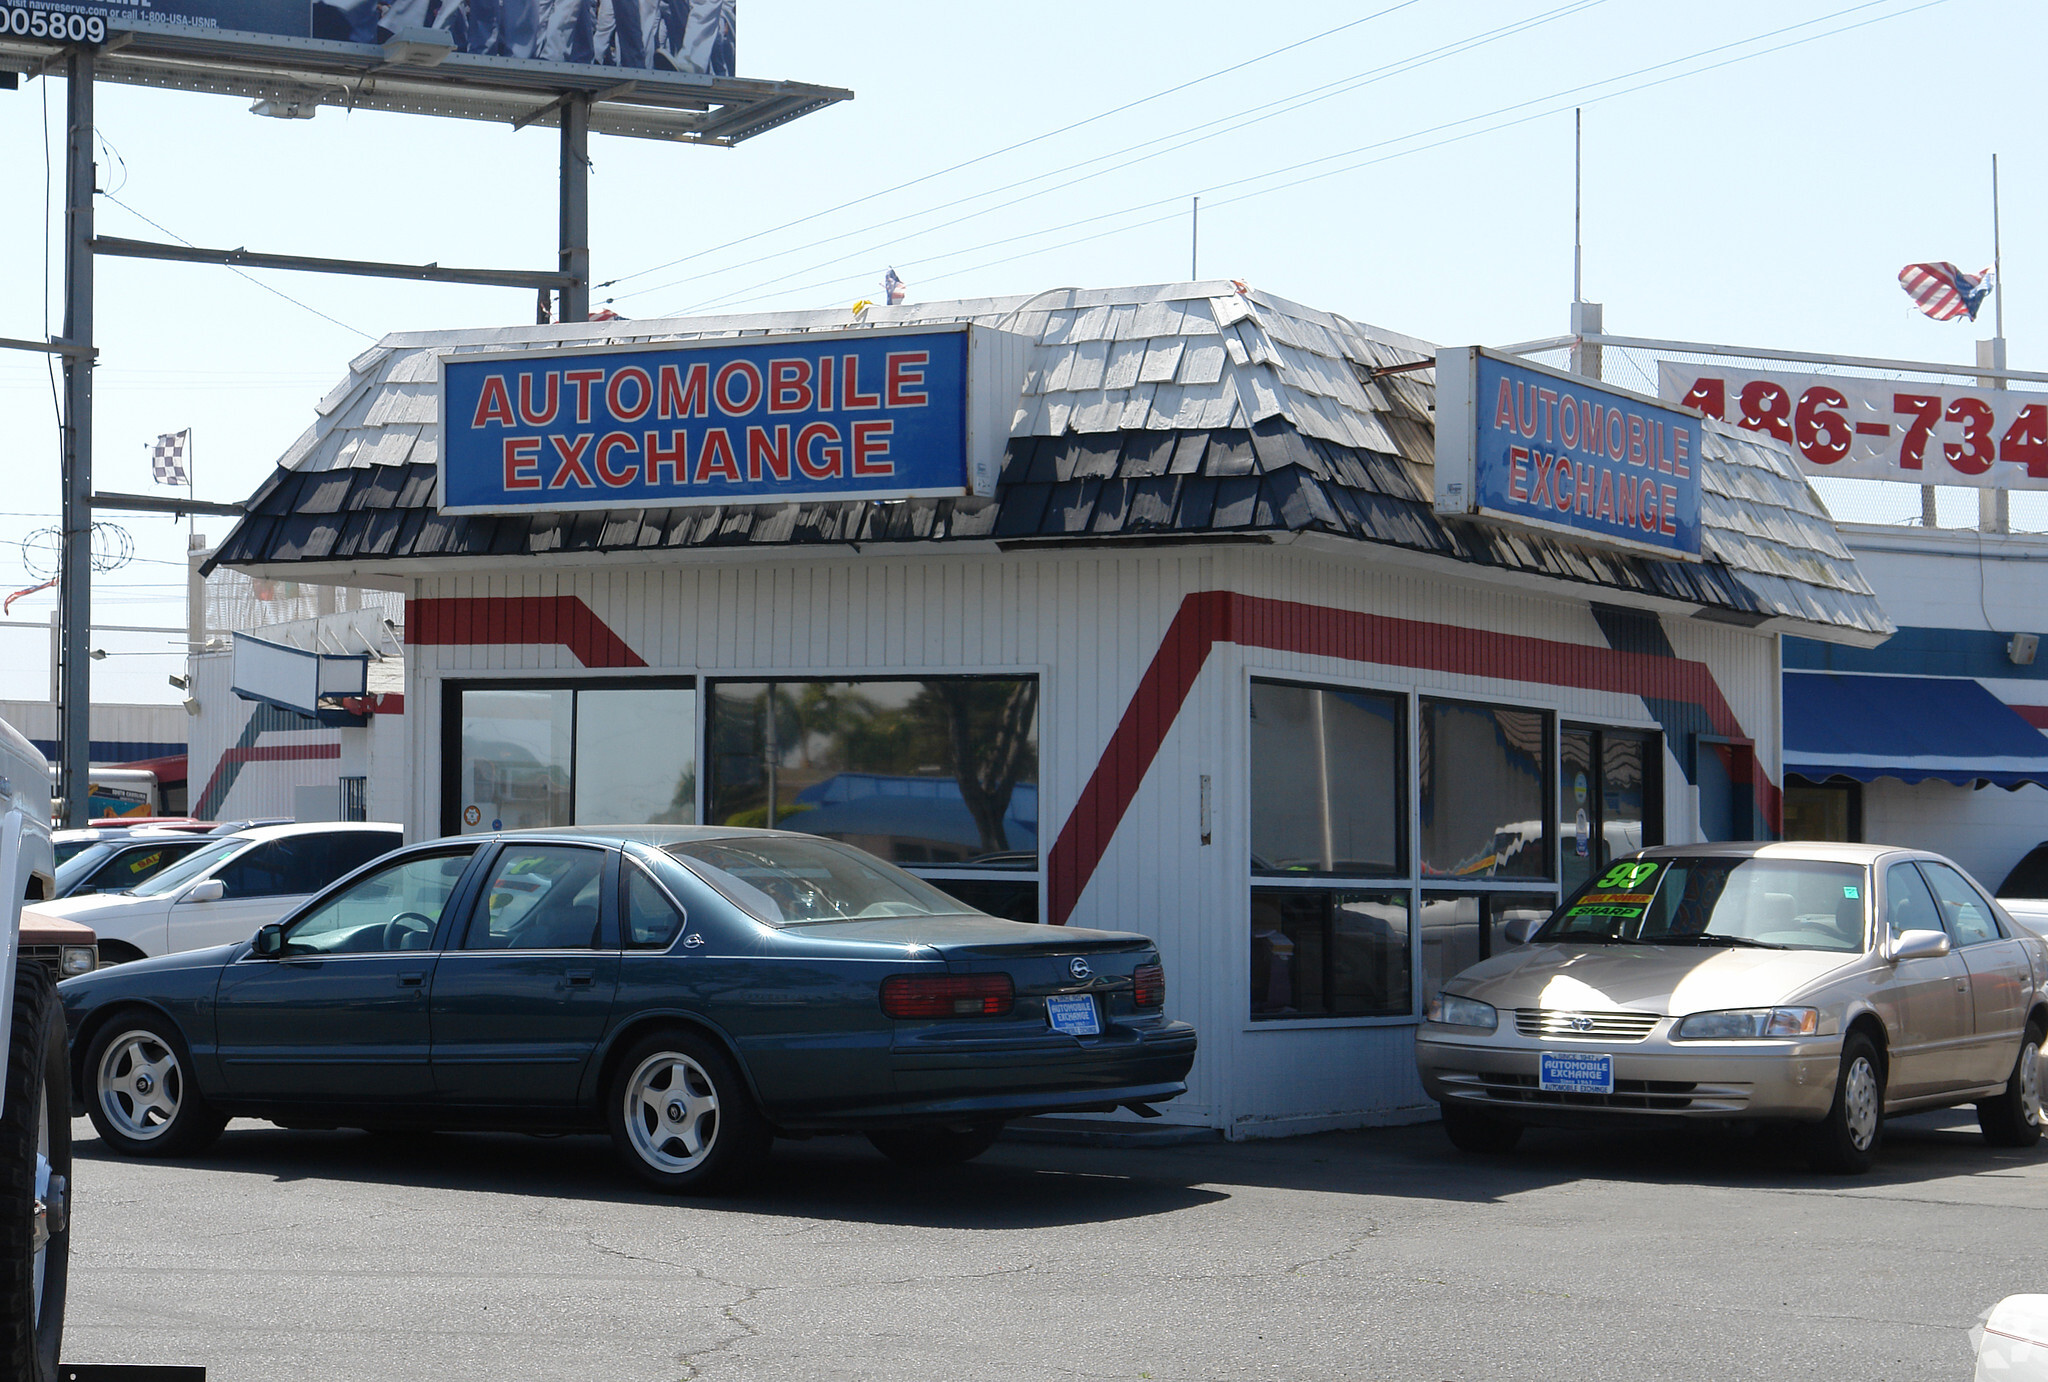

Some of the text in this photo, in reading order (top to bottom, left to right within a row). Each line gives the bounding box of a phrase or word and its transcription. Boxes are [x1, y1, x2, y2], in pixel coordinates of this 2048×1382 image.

[110, 8, 119, 17] or
[121, 9, 138, 20] call
[471, 350, 930, 430] AUTOMOBILE
[1493, 376, 1691, 480] AUTOMOBILE
[503, 419, 895, 492] EXCHANGE
[1509, 444, 1678, 537] EXCHANGE
[1597, 863, 1659, 888] 99
[1575, 907, 1635, 915] SHARP
[1545, 1060, 1608, 1071] AUTOMOBILE
[1550, 1069, 1603, 1079] EXCHANGE
